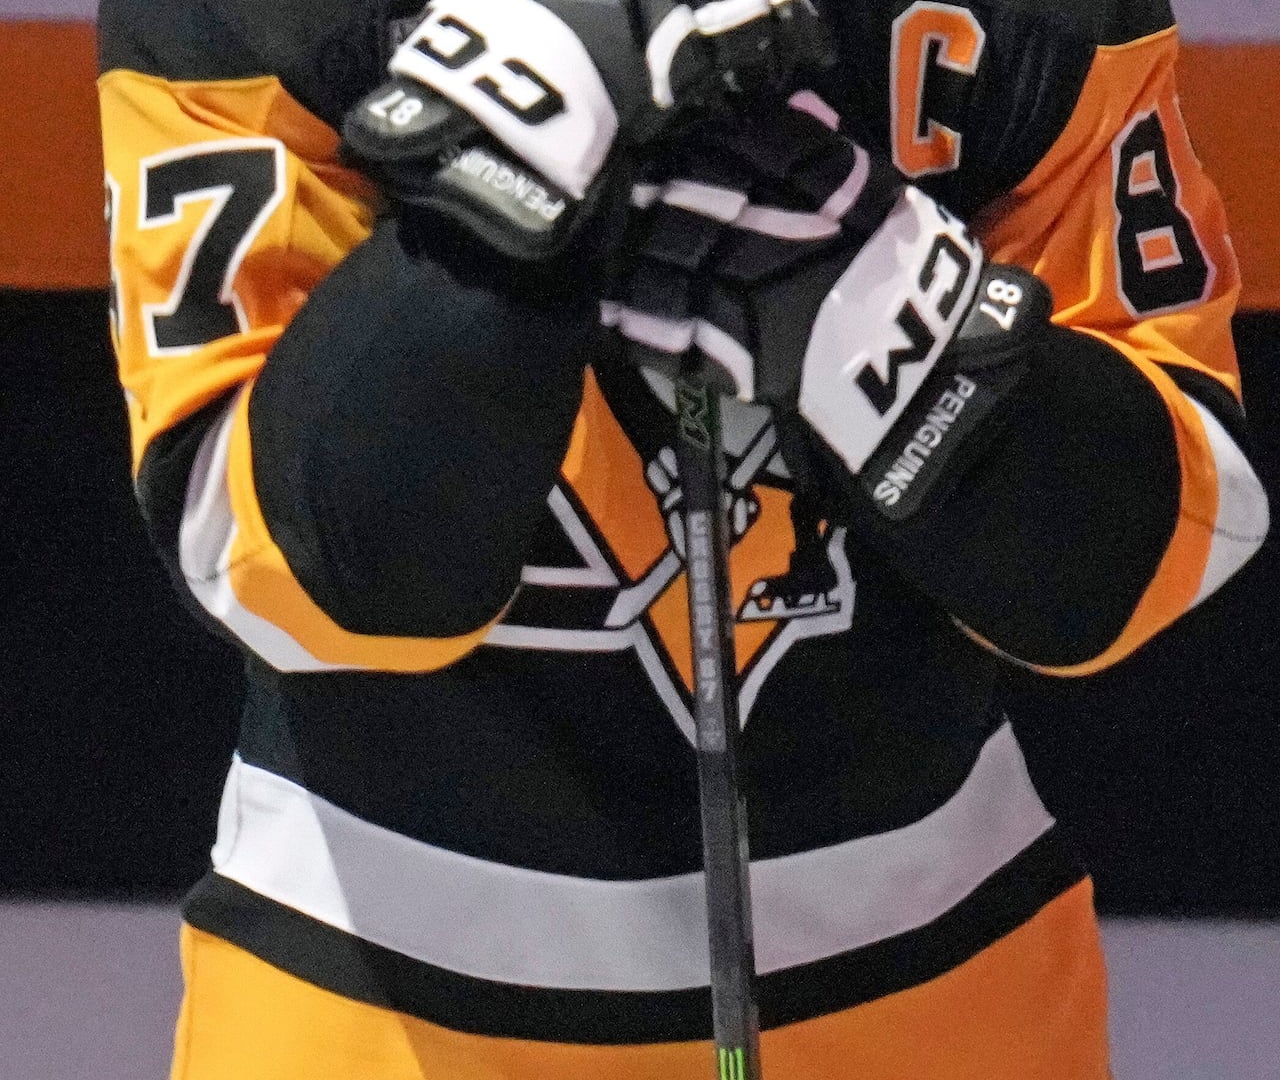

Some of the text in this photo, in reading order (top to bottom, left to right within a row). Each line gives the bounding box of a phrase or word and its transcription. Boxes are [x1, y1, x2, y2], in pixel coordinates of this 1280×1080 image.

[367, 89, 424, 126] 87
[405, 9, 567, 126] CC
[890, 0, 985, 178] C
[105, 137, 286, 358] 7
[1110, 104, 1218, 318] 8
[855, 206, 976, 419] CM
[979, 278, 1023, 331] 87
[873, 374, 978, 507] PENGUINS
